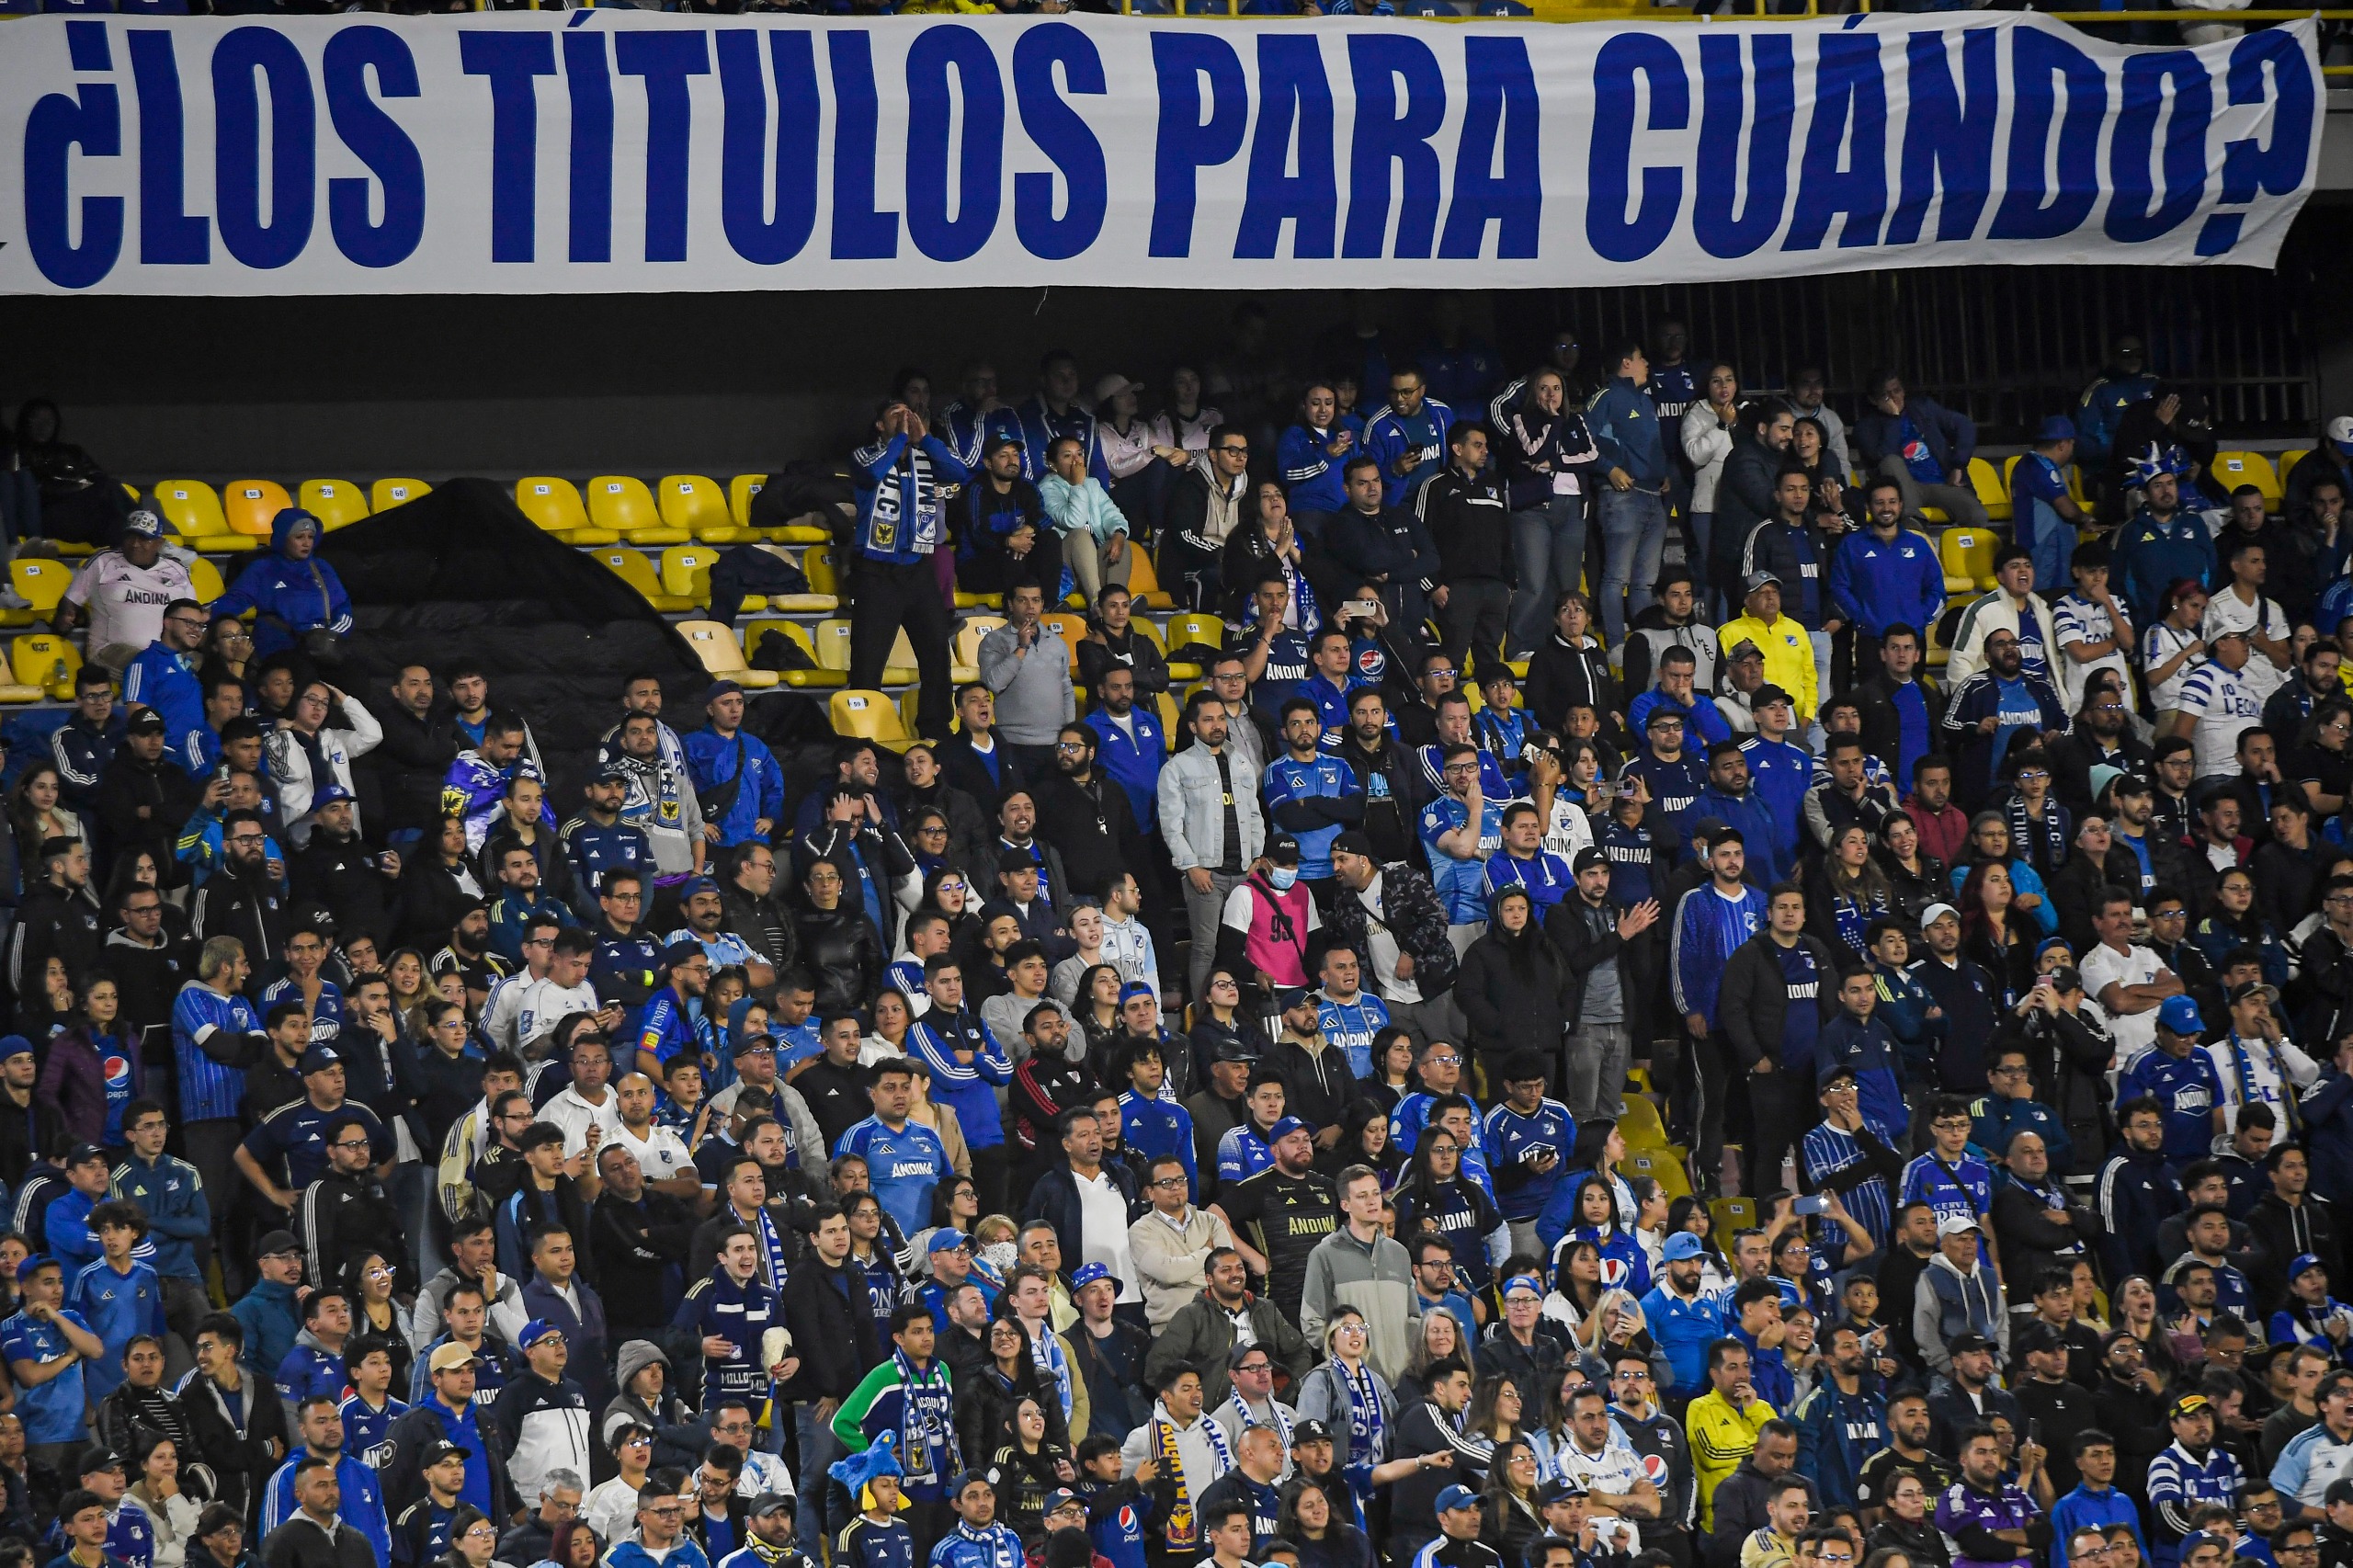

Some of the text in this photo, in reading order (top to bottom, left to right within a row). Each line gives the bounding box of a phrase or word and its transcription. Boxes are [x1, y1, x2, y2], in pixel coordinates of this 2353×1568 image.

[24, 9, 2316, 290] ¿LOS TÍTULOS PARA CUÁNDO?
